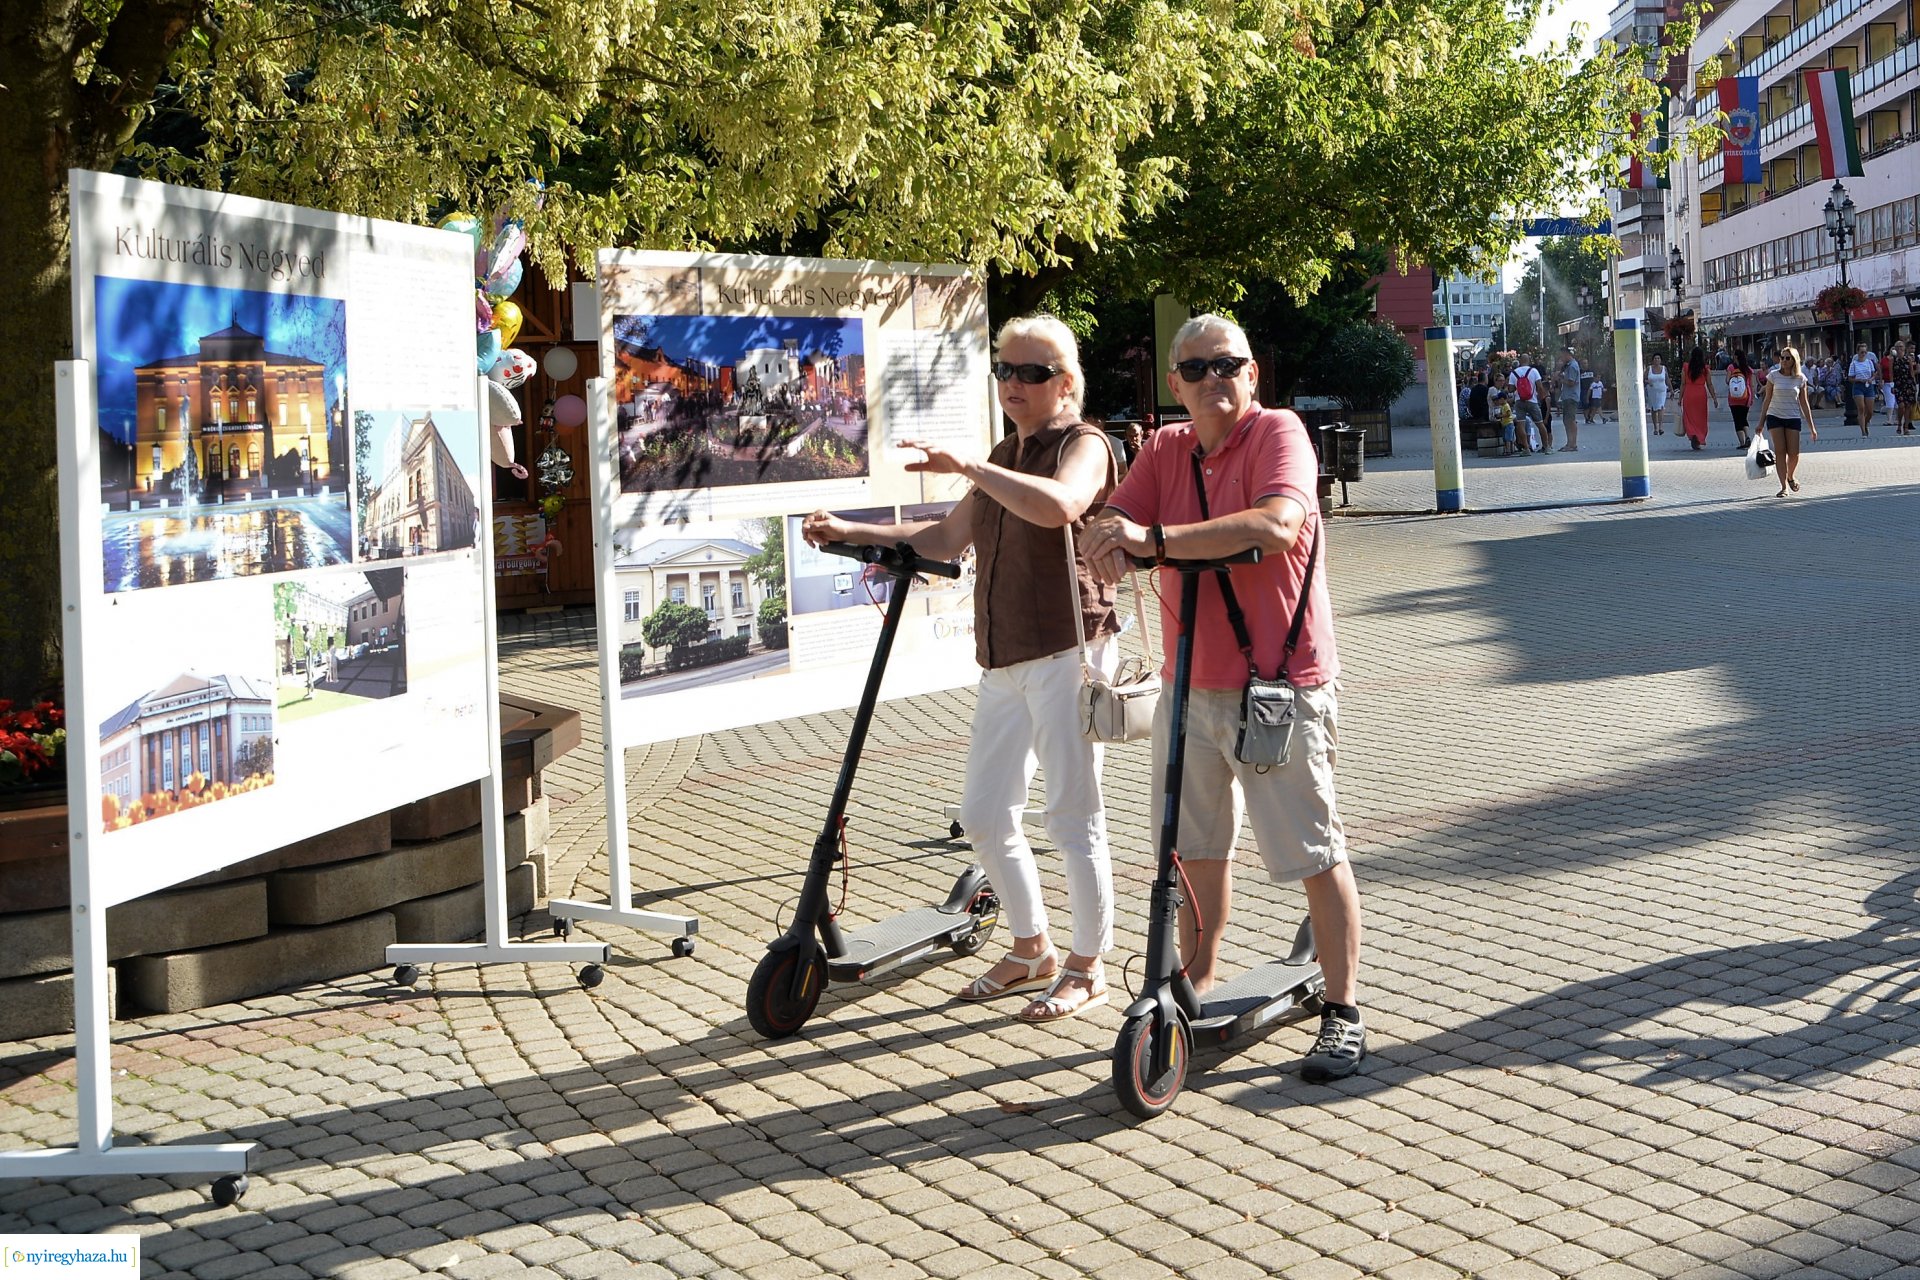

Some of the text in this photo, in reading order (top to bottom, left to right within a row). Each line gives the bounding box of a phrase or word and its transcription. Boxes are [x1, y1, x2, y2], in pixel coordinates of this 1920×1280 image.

[115, 226, 326, 282] Kulturális Negyed
[717, 283, 899, 312] Kulturális Negyed
